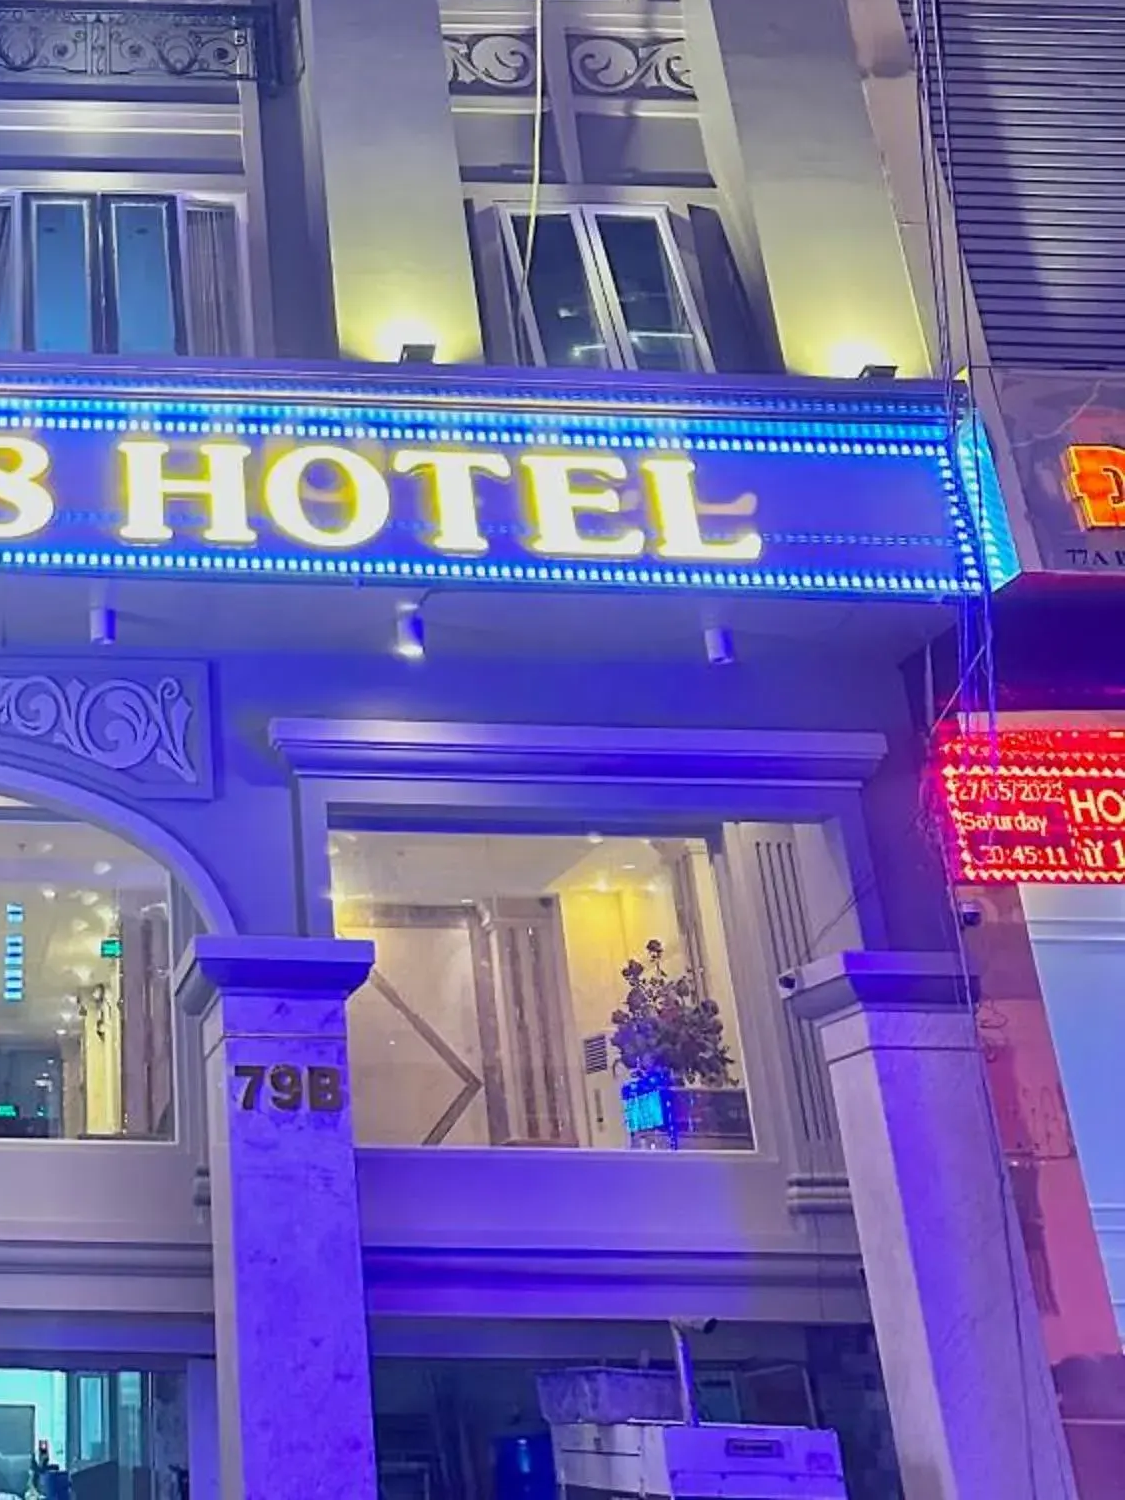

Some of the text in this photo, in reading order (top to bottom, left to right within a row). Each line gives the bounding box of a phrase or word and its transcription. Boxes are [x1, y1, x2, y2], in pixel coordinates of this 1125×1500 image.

[116, 440, 763, 559] HOTEL
[961, 811, 1048, 837] Saturday
[1068, 788, 1125, 824] HO
[234, 1064, 345, 1112] 79B
